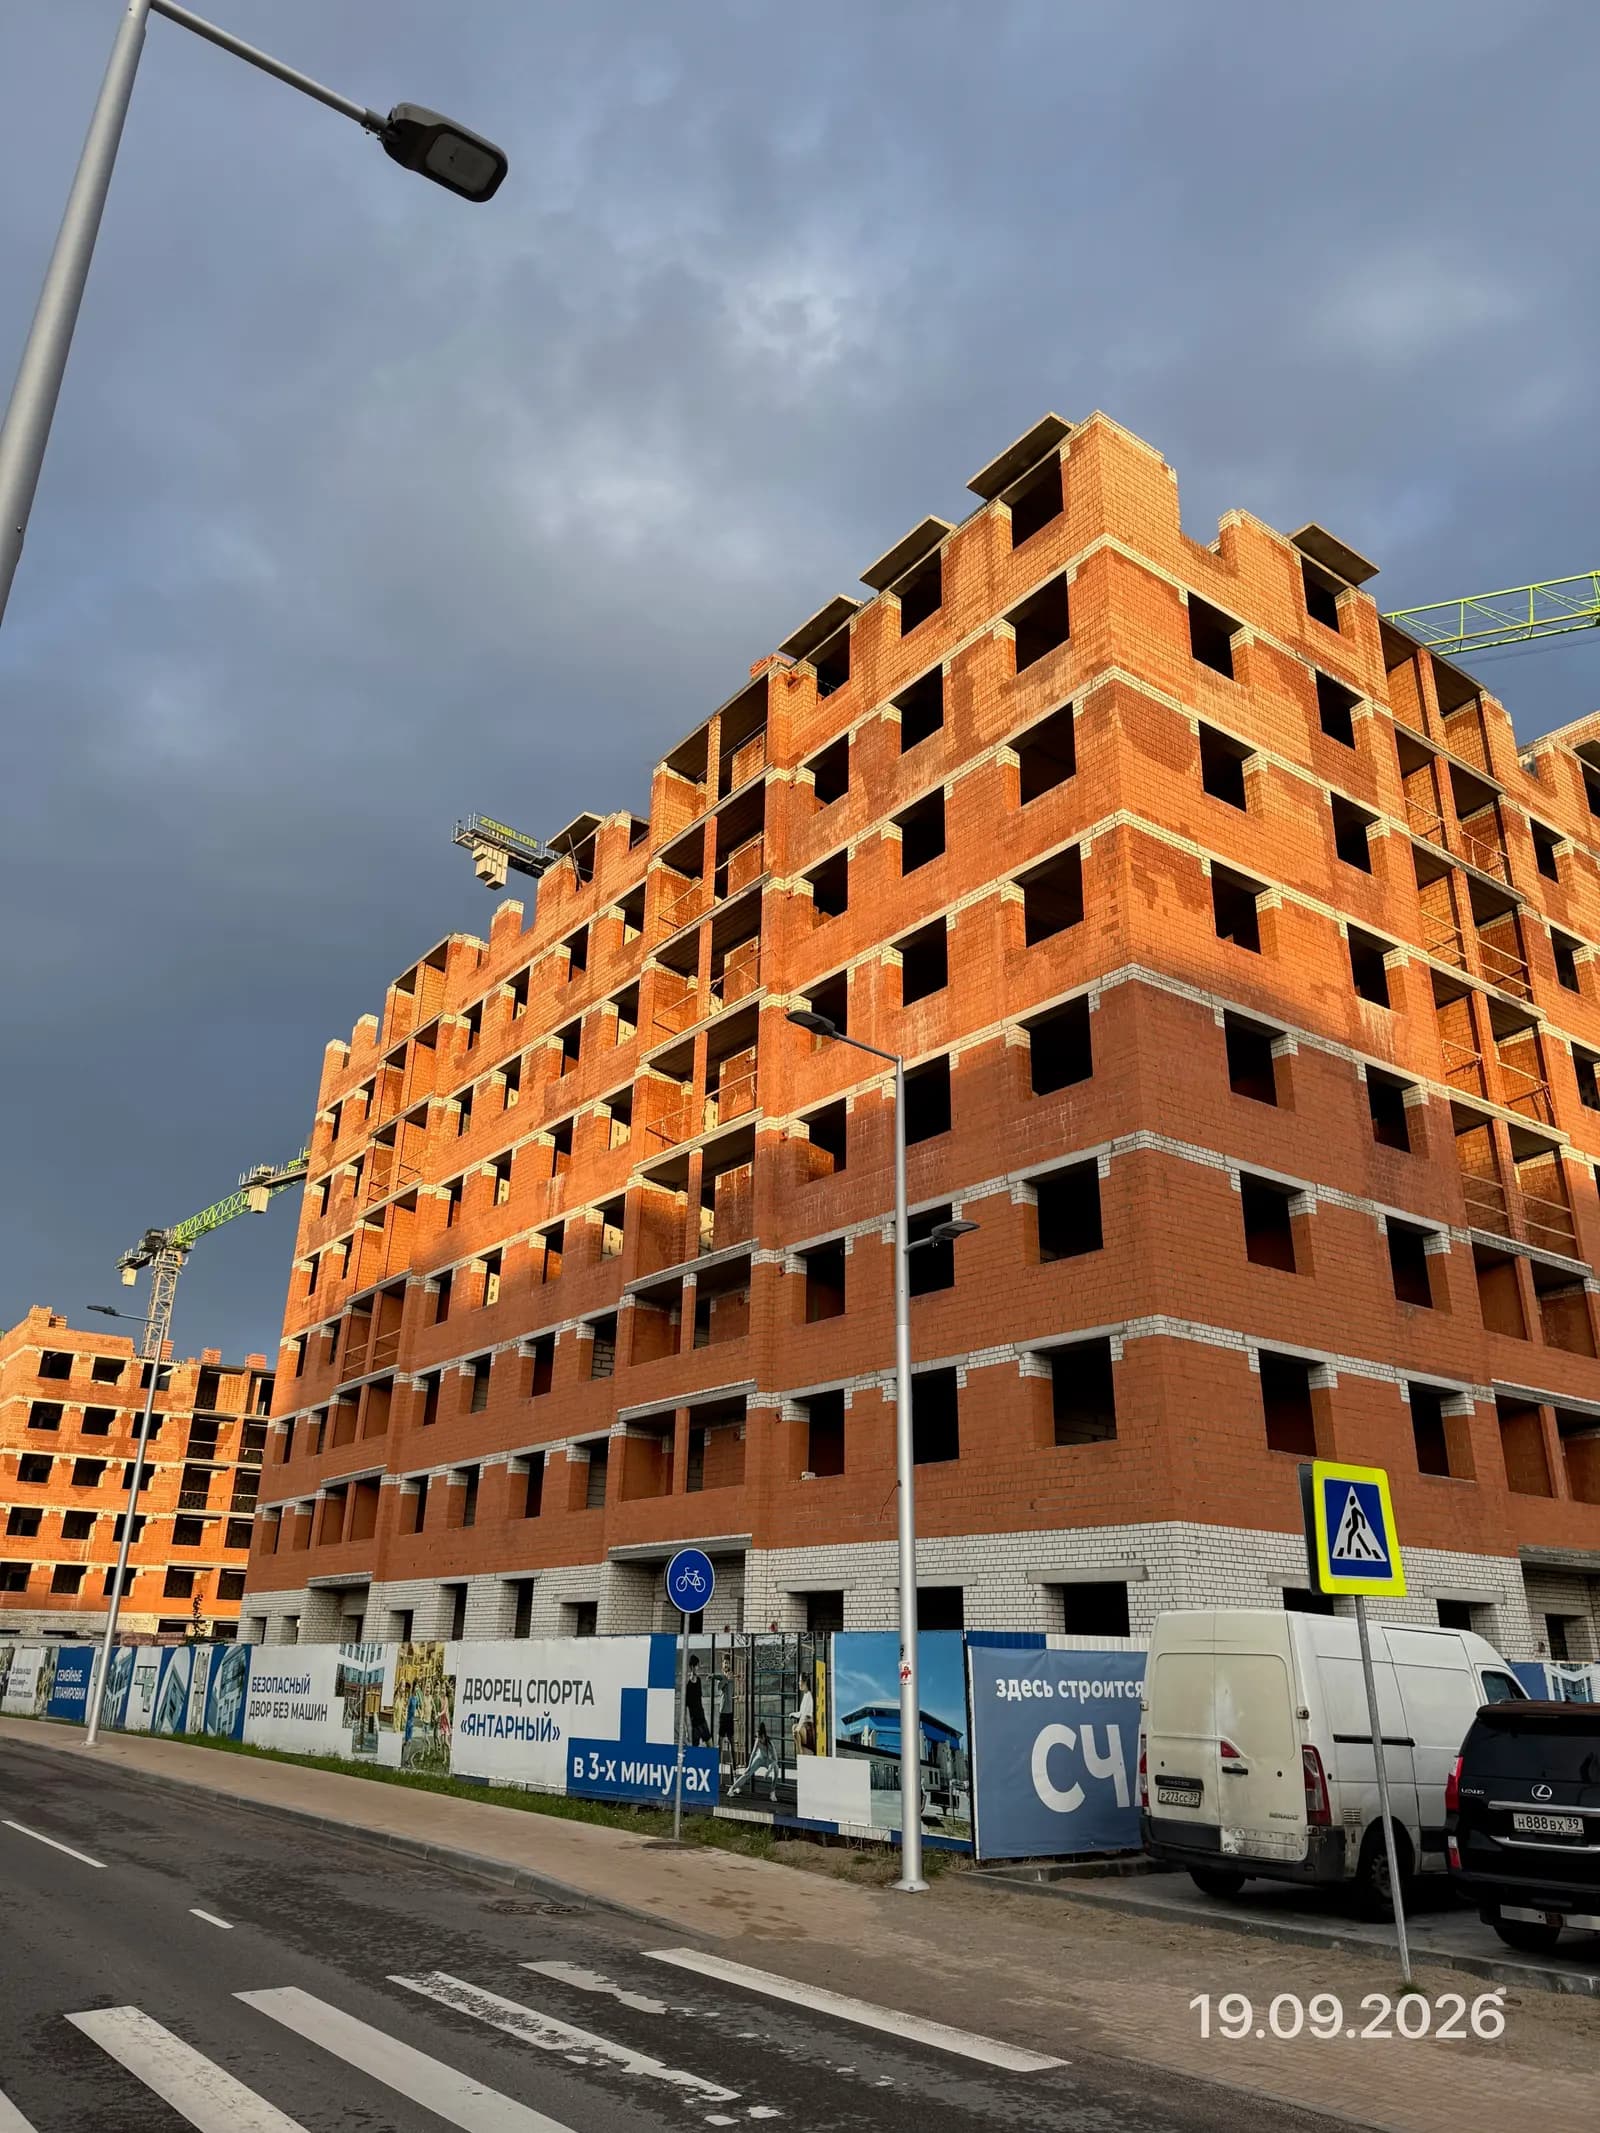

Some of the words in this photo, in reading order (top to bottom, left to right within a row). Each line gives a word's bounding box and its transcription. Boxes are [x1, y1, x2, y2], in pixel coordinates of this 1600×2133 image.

[480, 815, 538, 849] ZOOMLION
[251, 1673, 311, 1695] БЕЗОПАСНЫЙ
[463, 1678, 522, 1707] ДВОРЕЦ
[526, 1679, 595, 1705] СПОРТА
[995, 1678, 1054, 1701] здесь
[1058, 1680, 1144, 1704] строится
[249, 1700, 272, 1720] ДВОР
[272, 1701, 290, 1719] БЕЗ
[290, 1703, 328, 1722] МАШИН
[460, 1711, 561, 1742] «ЯНТАРНЫЙ»
[573, 1757, 584, 1778] в
[588, 1752, 616, 1781] 3-х
[1031, 1723, 1143, 1813] СЧ
